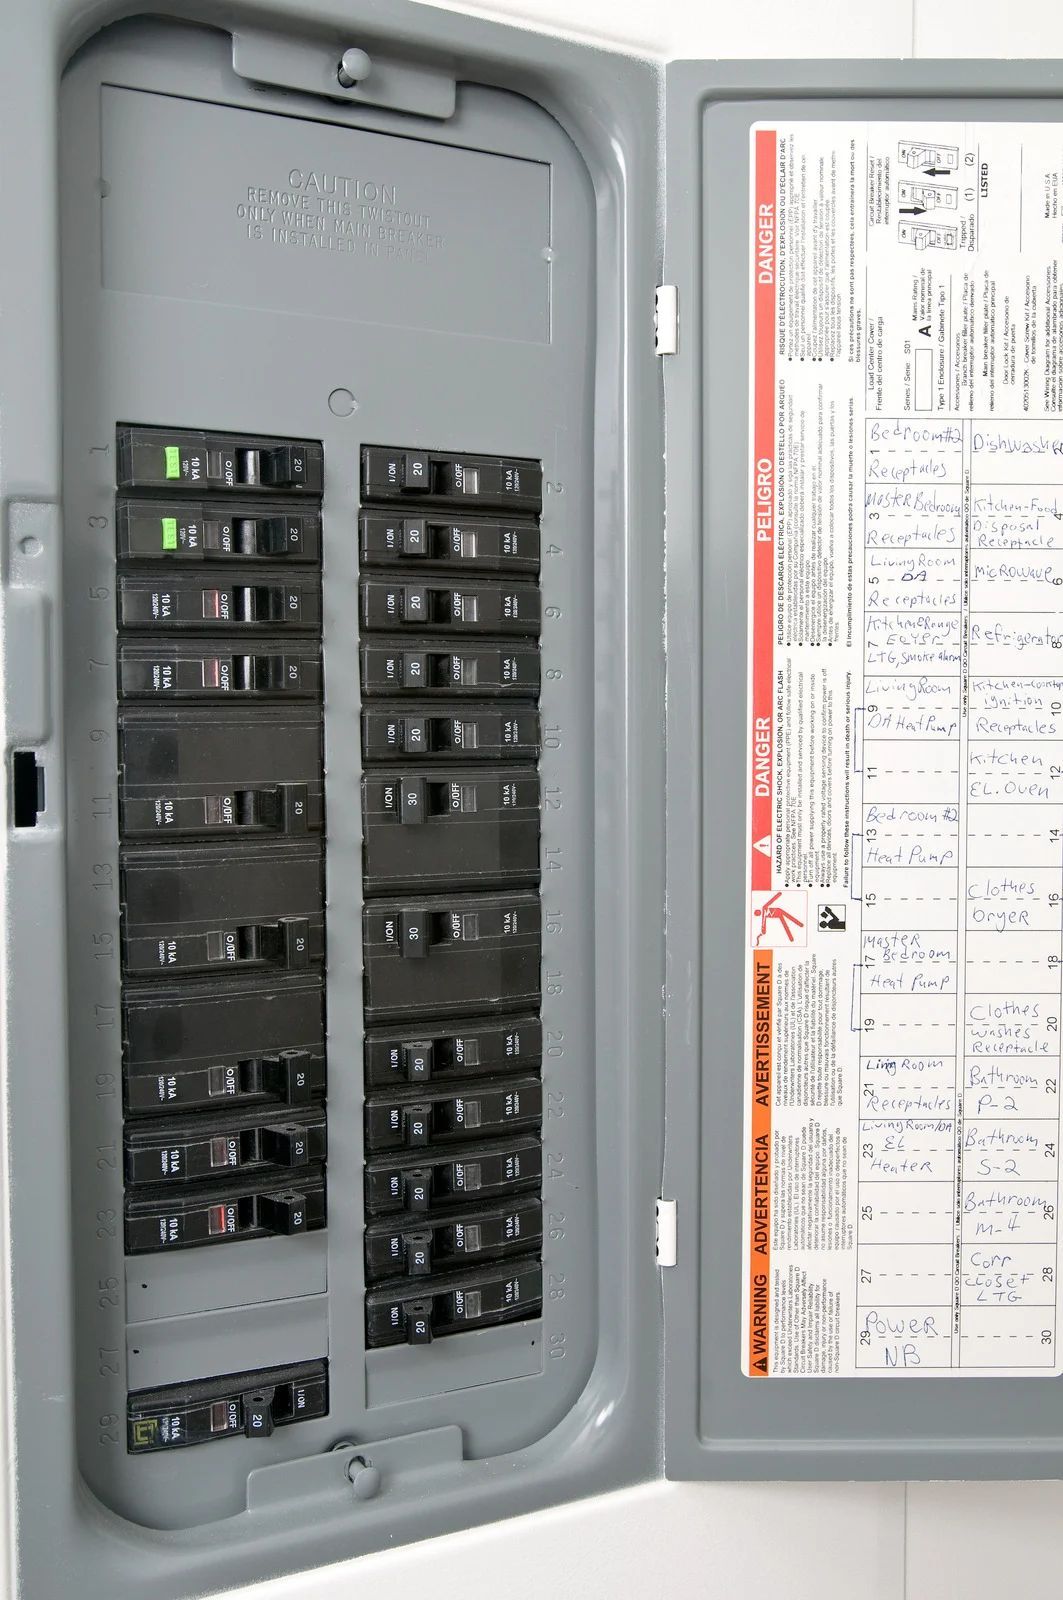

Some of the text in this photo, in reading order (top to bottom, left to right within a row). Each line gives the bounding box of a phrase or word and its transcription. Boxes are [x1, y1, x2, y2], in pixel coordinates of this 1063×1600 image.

[965, 152, 975, 166] (2)
[288, 168, 396, 205] CAUTION
[965, 187, 975, 201] (1)
[247, 186, 431, 230] REMOVE THIS TWISTOUT
[236, 203, 444, 249] ONLY WHEN MAIN BREAKER
[247, 224, 264, 240] IS
[272, 226, 355, 253] INSTALLED
[365, 241, 379, 257] IN
[758, 204, 774, 284] DANGER
[938, 291, 946, 306] Tipo
[918, 325, 931, 337] A
[876, 338, 883, 347] de
[295, 458, 302, 472] 20
[413, 462, 422, 476] 20
[868, 458, 947, 482] Receptacles
[547, 482, 564, 494] 2
[756, 458, 772, 542] PELIGRO
[88, 516, 108, 529] 3
[868, 512, 880, 520] 3
[973, 518, 1039, 536] Disposal
[867, 524, 956, 546] Receptacles
[978, 533, 1055, 549] Receptacle
[871, 553, 956, 571] Living Room
[868, 576, 879, 584] 5
[1052, 578, 1062, 586] 6
[545, 606, 562, 620] 6
[865, 680, 916, 701] Living
[918, 676, 951, 695] Room
[1051, 702, 1062, 716] 10
[777, 712, 785, 722] OR
[925, 715, 957, 736] Pump
[976, 716, 1057, 735] Receptacles
[412, 728, 421, 742] 20
[545, 724, 562, 750] 10
[777, 724, 785, 766] EXPLOSION,
[755, 716, 770, 796] DANGER
[970, 749, 1043, 767] Kitchen
[867, 767, 877, 779] 11
[1050, 766, 1061, 780] 12
[1004, 781, 1049, 799] Oven
[408, 793, 417, 806] 30
[545, 786, 562, 811] 12
[866, 806, 938, 824] Bedroom
[776, 833, 783, 842] OF
[866, 828, 877, 842] 13
[1050, 828, 1060, 843] 14
[866, 845, 953, 865] Heat Pump
[92, 864, 112, 890] 13
[968, 878, 1036, 898] Clothes
[866, 893, 876, 907] 15
[1048, 893, 1060, 908] 16
[546, 910, 562, 935] 16
[409, 927, 418, 940] 30
[296, 938, 304, 951] 20
[883, 947, 950, 961] Bedroom
[865, 956, 876, 968] 17
[1048, 956, 1058, 969] 18
[870, 972, 950, 991] Heat Pump
[970, 1000, 1039, 1020] Clothes
[864, 1018, 875, 1032] 19
[1046, 1016, 1058, 1032] 20
[755, 961, 770, 1107] AVERTISSEMENT
[972, 1040, 1049, 1053] Receptacle
[415, 1058, 424, 1071] 20
[901, 1059, 943, 1071] Room
[970, 1065, 1038, 1087] Bathroom
[96, 1073, 116, 1099] 19
[864, 1082, 874, 1096] 21
[1046, 1078, 1056, 1094] 22
[867, 1095, 950, 1112] Receptacles
[977, 1094, 1018, 1115] P-2
[862, 1120, 904, 1133] Living
[965, 1128, 1039, 1147] Bathroom
[862, 1144, 874, 1158] 23
[1045, 1143, 1055, 1158] 24
[977, 1159, 1020, 1176] S-2
[754, 1134, 768, 1254] ADVERTENCIA
[965, 1191, 1048, 1212] Bathroom
[862, 1206, 872, 1220] 25
[1044, 1206, 1054, 1220] 26
[971, 1252, 1012, 1269] Corr
[861, 1269, 872, 1284] 27
[1042, 1266, 1053, 1282] 28
[977, 1290, 1022, 1302] LTG
[753, 1274, 767, 1354] WARNING
[416, 1321, 425, 1334] 20
[860, 1330, 871, 1346] 29
[1041, 1330, 1052, 1345] 30
[885, 1344, 921, 1367] NB
[253, 1414, 262, 1428] 20
